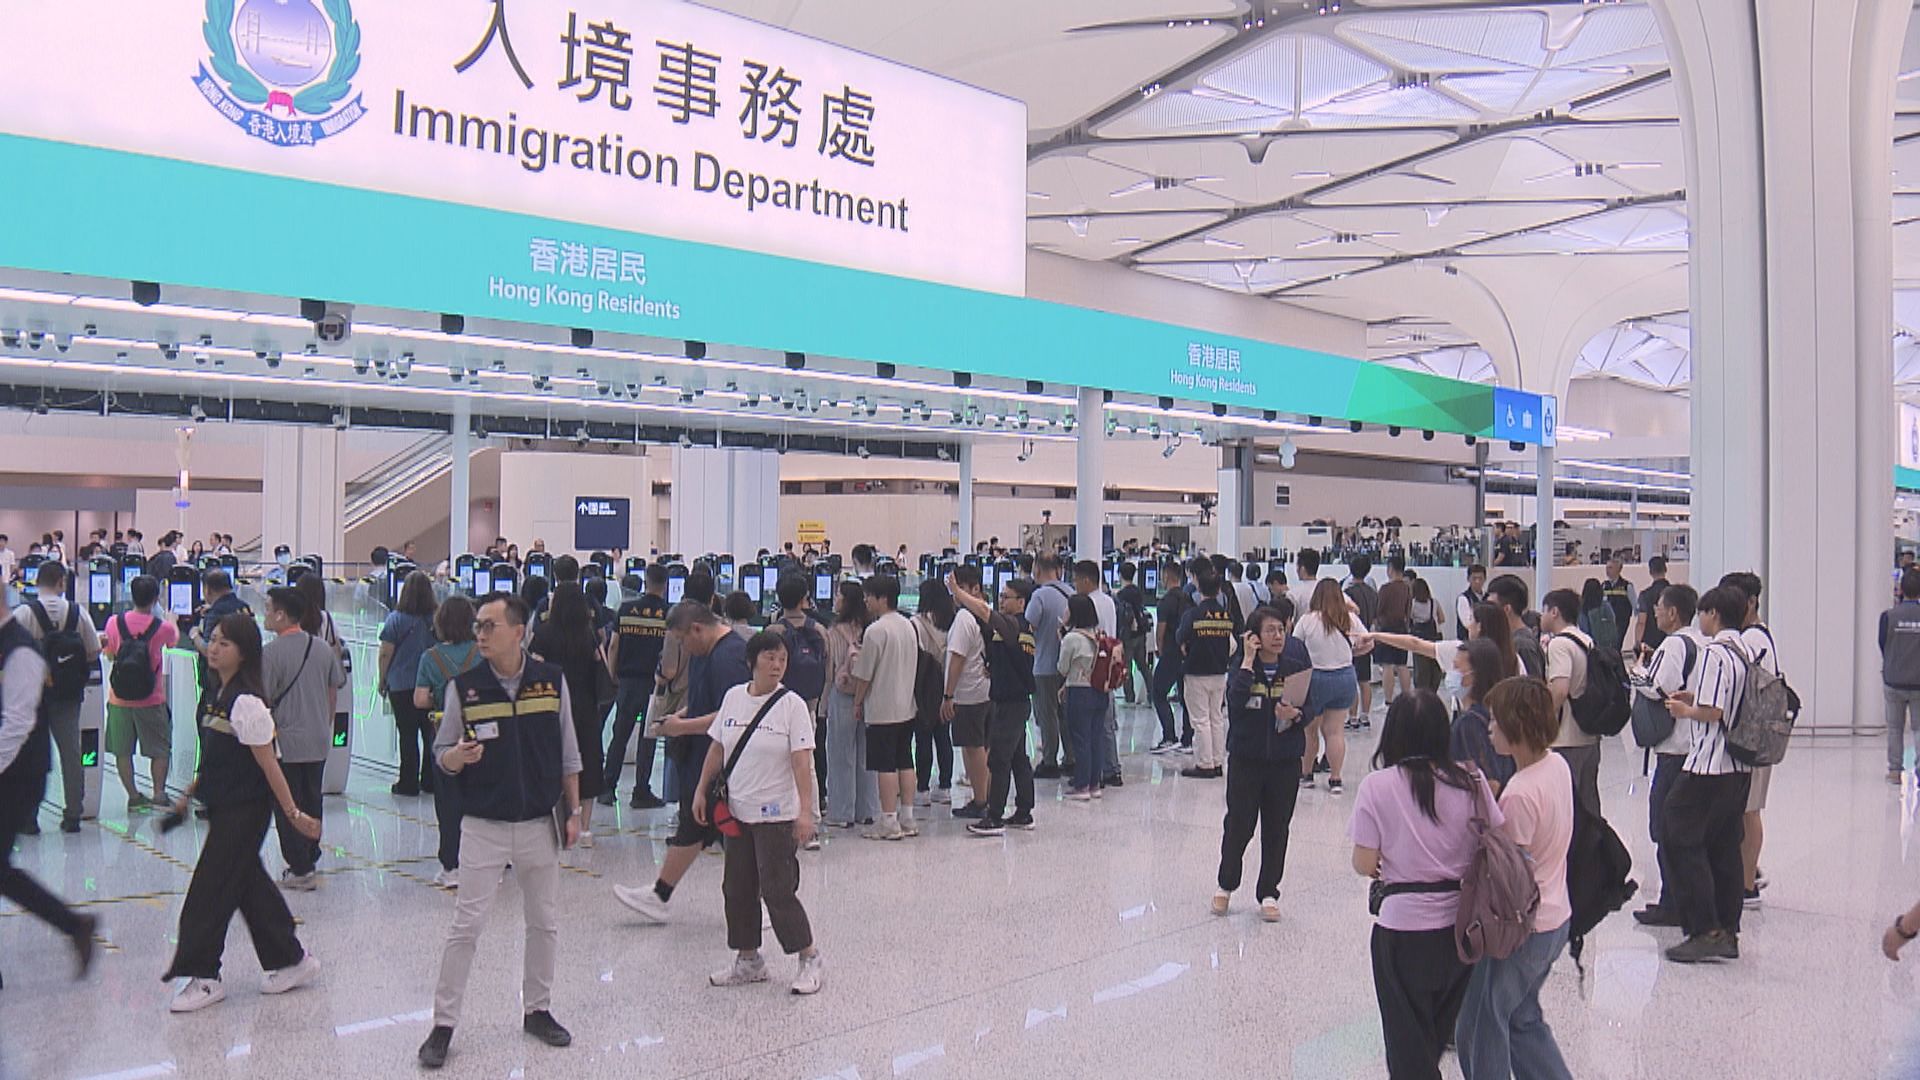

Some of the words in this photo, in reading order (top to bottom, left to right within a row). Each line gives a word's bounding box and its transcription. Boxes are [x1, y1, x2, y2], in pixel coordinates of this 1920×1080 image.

[454, 0, 877, 168] 入境事務處
[394, 89, 678, 187] Immigration
[694, 151, 910, 233] Department
[529, 237, 646, 286] 香港居民
[489, 275, 541, 308] Hong
[545, 284, 593, 314] Kong
[598, 290, 681, 320] Residents
[1188, 342, 1241, 373] 香港居民
[1170, 369, 1194, 390] Hong
[1195, 373, 1217, 393] Kong
[1219, 376, 1257, 396] Residents
